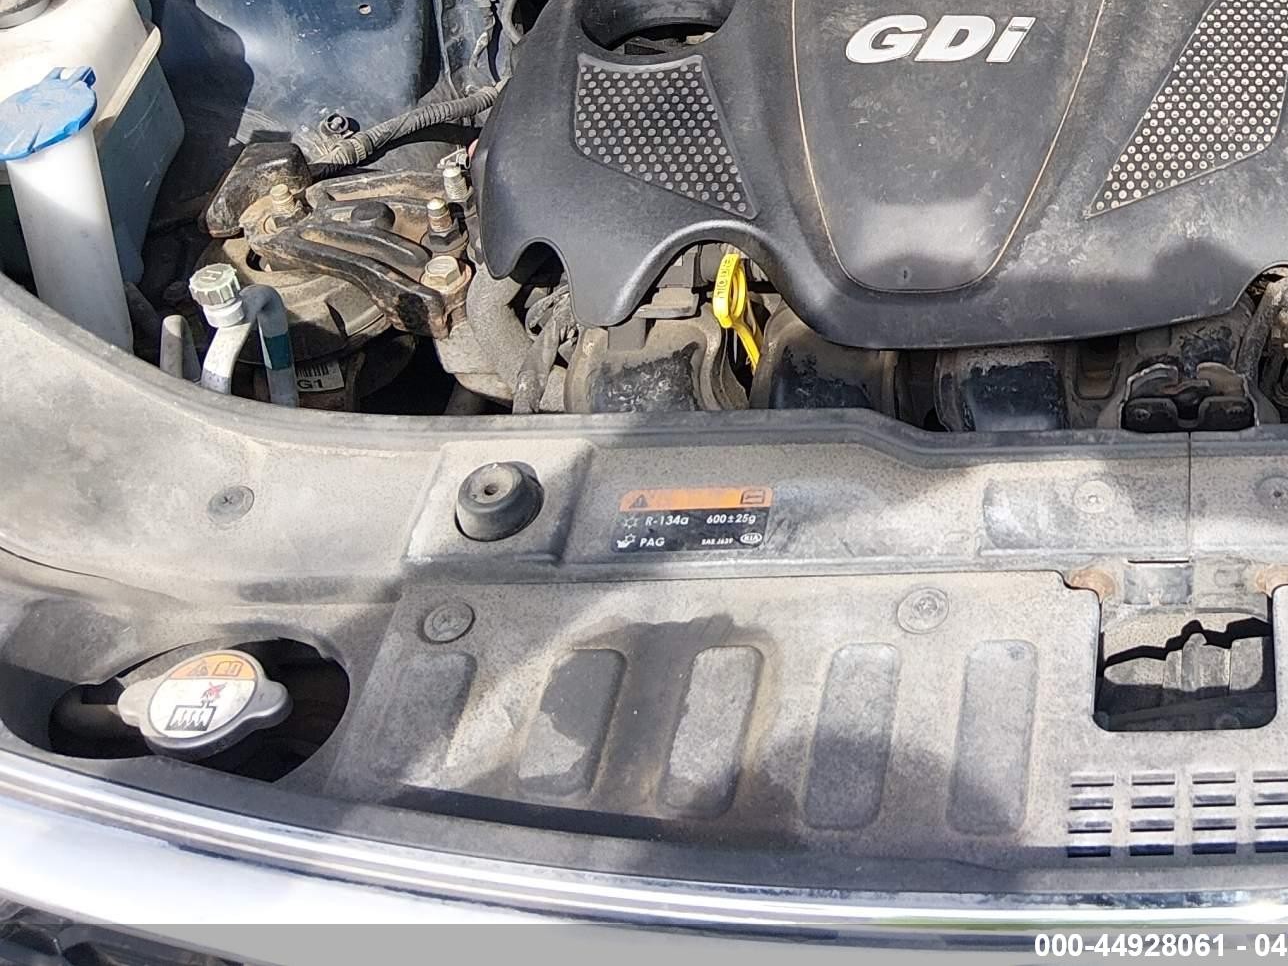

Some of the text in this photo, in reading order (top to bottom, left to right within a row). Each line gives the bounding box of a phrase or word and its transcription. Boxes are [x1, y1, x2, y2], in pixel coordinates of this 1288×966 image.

[845, 14, 1037, 64] GDi
[645, 515, 689, 526] R-134a
[639, 537, 665, 547] PAG
